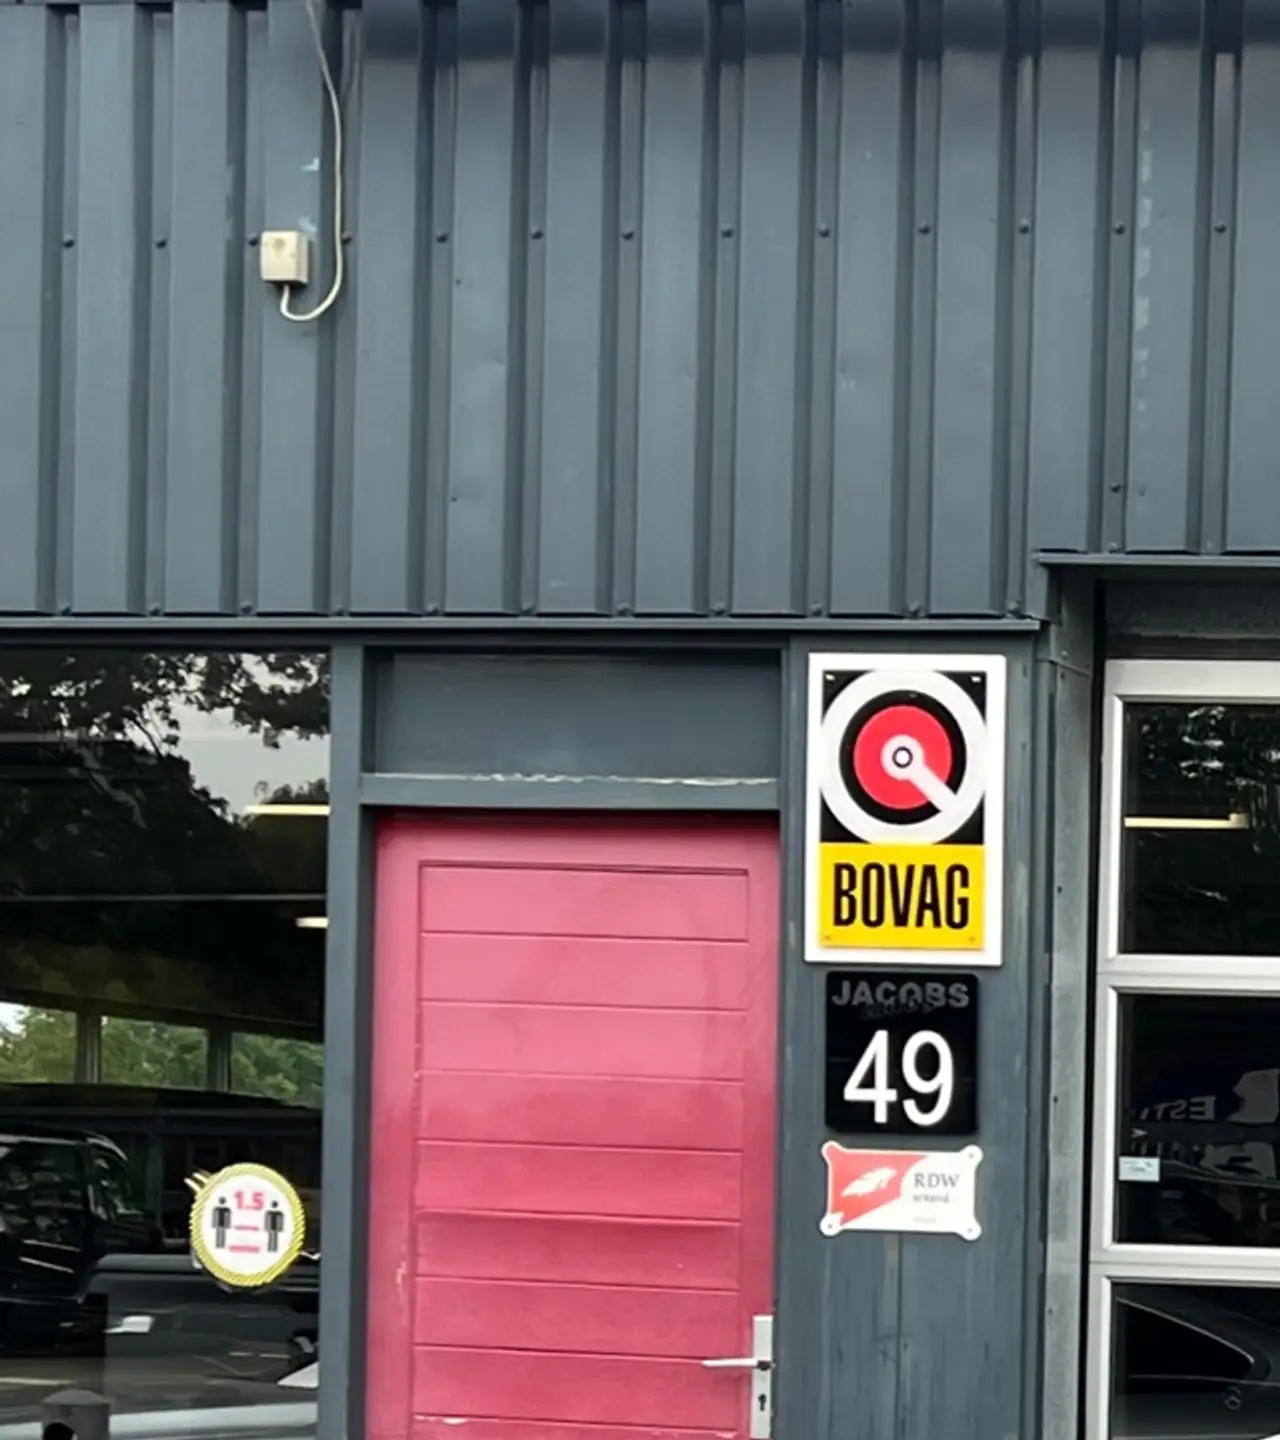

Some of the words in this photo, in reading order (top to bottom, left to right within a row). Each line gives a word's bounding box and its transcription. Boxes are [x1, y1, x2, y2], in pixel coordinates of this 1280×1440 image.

[833, 862, 970, 929] BOVAG
[832, 980, 969, 1008] JACOBS
[843, 1029, 954, 1126] 49
[914, 1172, 960, 1188] RDW
